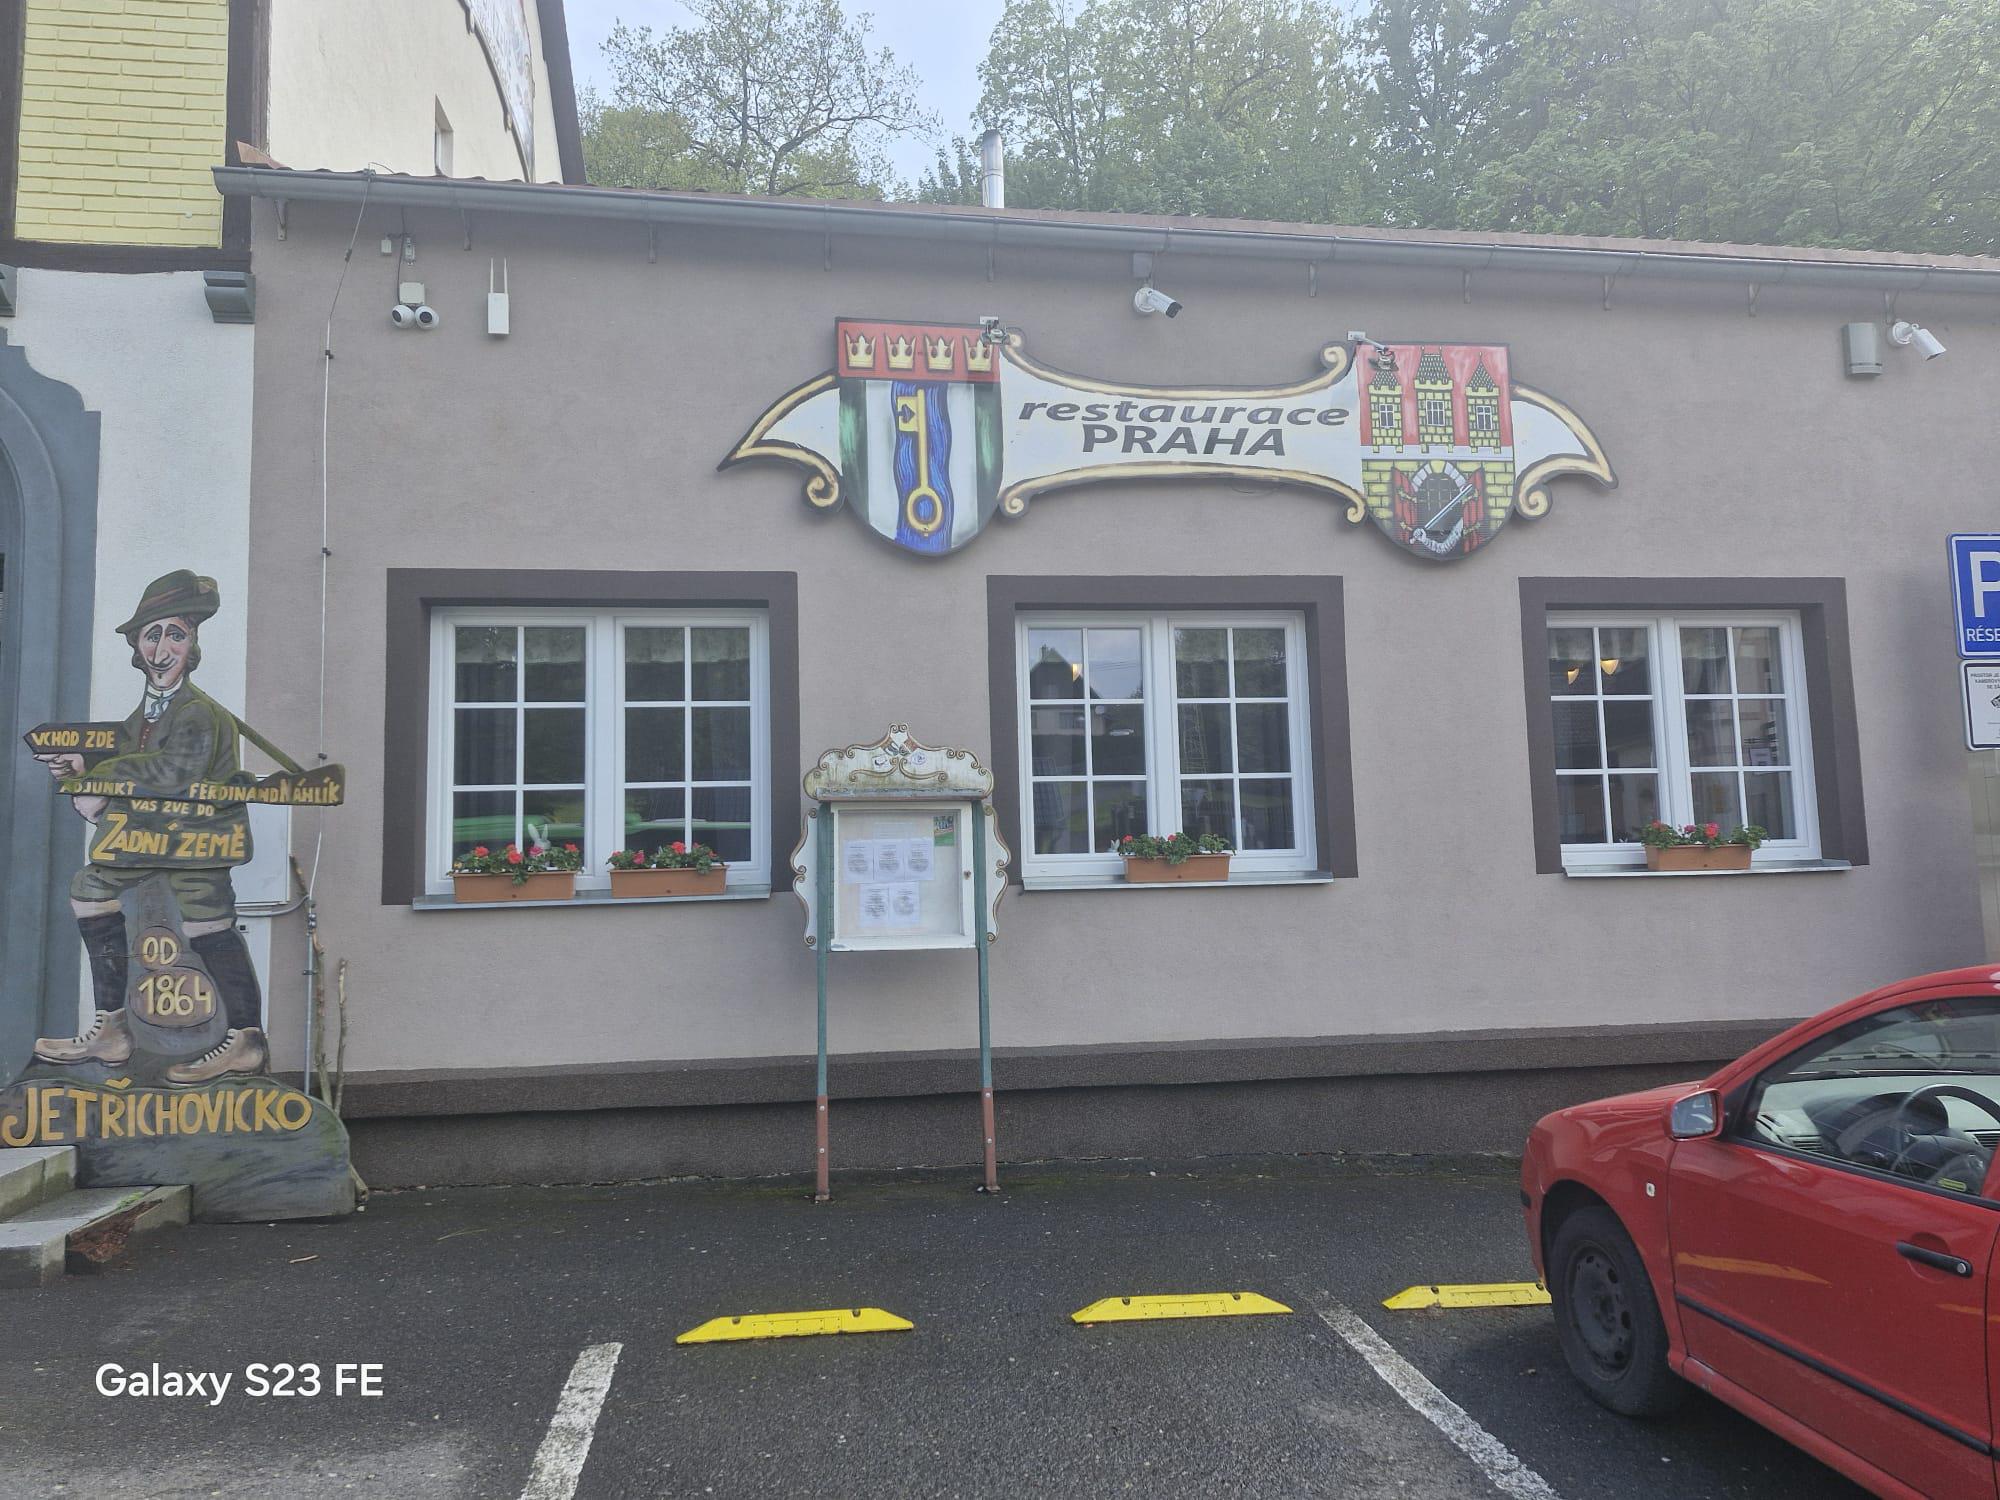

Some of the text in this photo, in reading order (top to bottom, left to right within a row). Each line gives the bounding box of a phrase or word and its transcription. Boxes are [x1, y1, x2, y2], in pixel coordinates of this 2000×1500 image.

[1019, 400, 1349, 426] restaurace
[1082, 423, 1286, 457] PRAHA
[1969, 551, 2000, 618] P
[30, 730, 116, 749] VCHOD ZDE
[189, 782, 280, 803] FERDINAND
[196, 803, 215, 817] DO
[93, 813, 245, 861] ZADNÍ ZEMĚ
[142, 936, 179, 965] OD
[138, 974, 212, 1016] 1864
[1, 1077, 313, 1147] JETŘICHOVICKO
